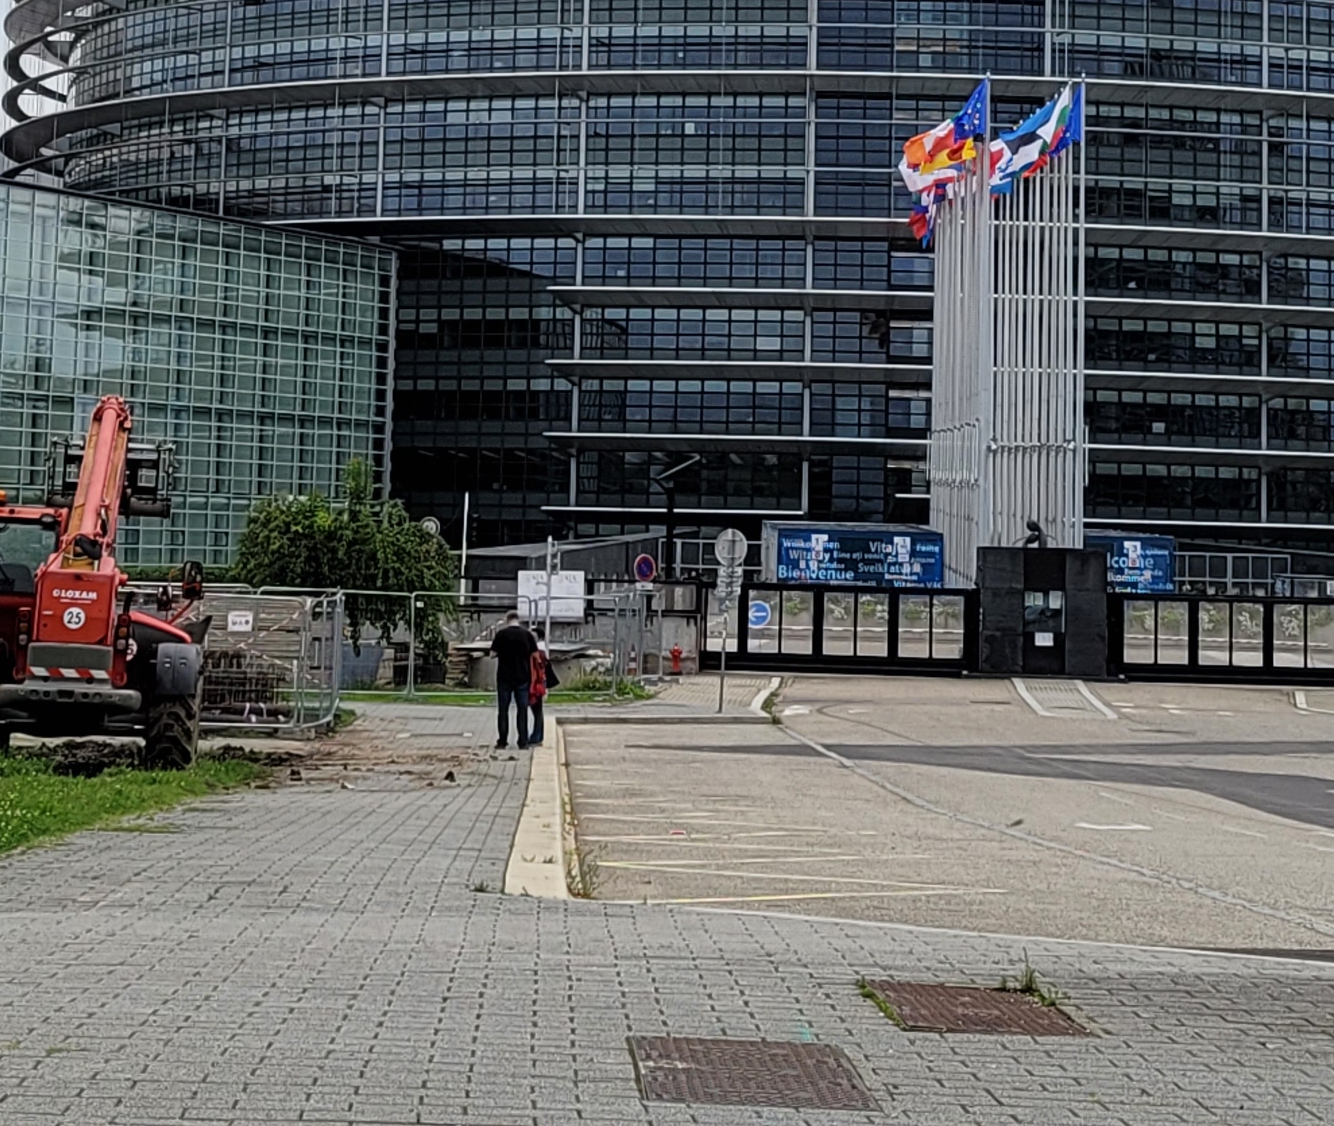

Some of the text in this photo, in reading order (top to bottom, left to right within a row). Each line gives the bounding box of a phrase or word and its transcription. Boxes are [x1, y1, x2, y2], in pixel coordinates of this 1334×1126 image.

[778, 565, 854, 581] Bienvenue
[61, 589, 98, 600] LOXAM
[67, 611, 82, 625] 25
